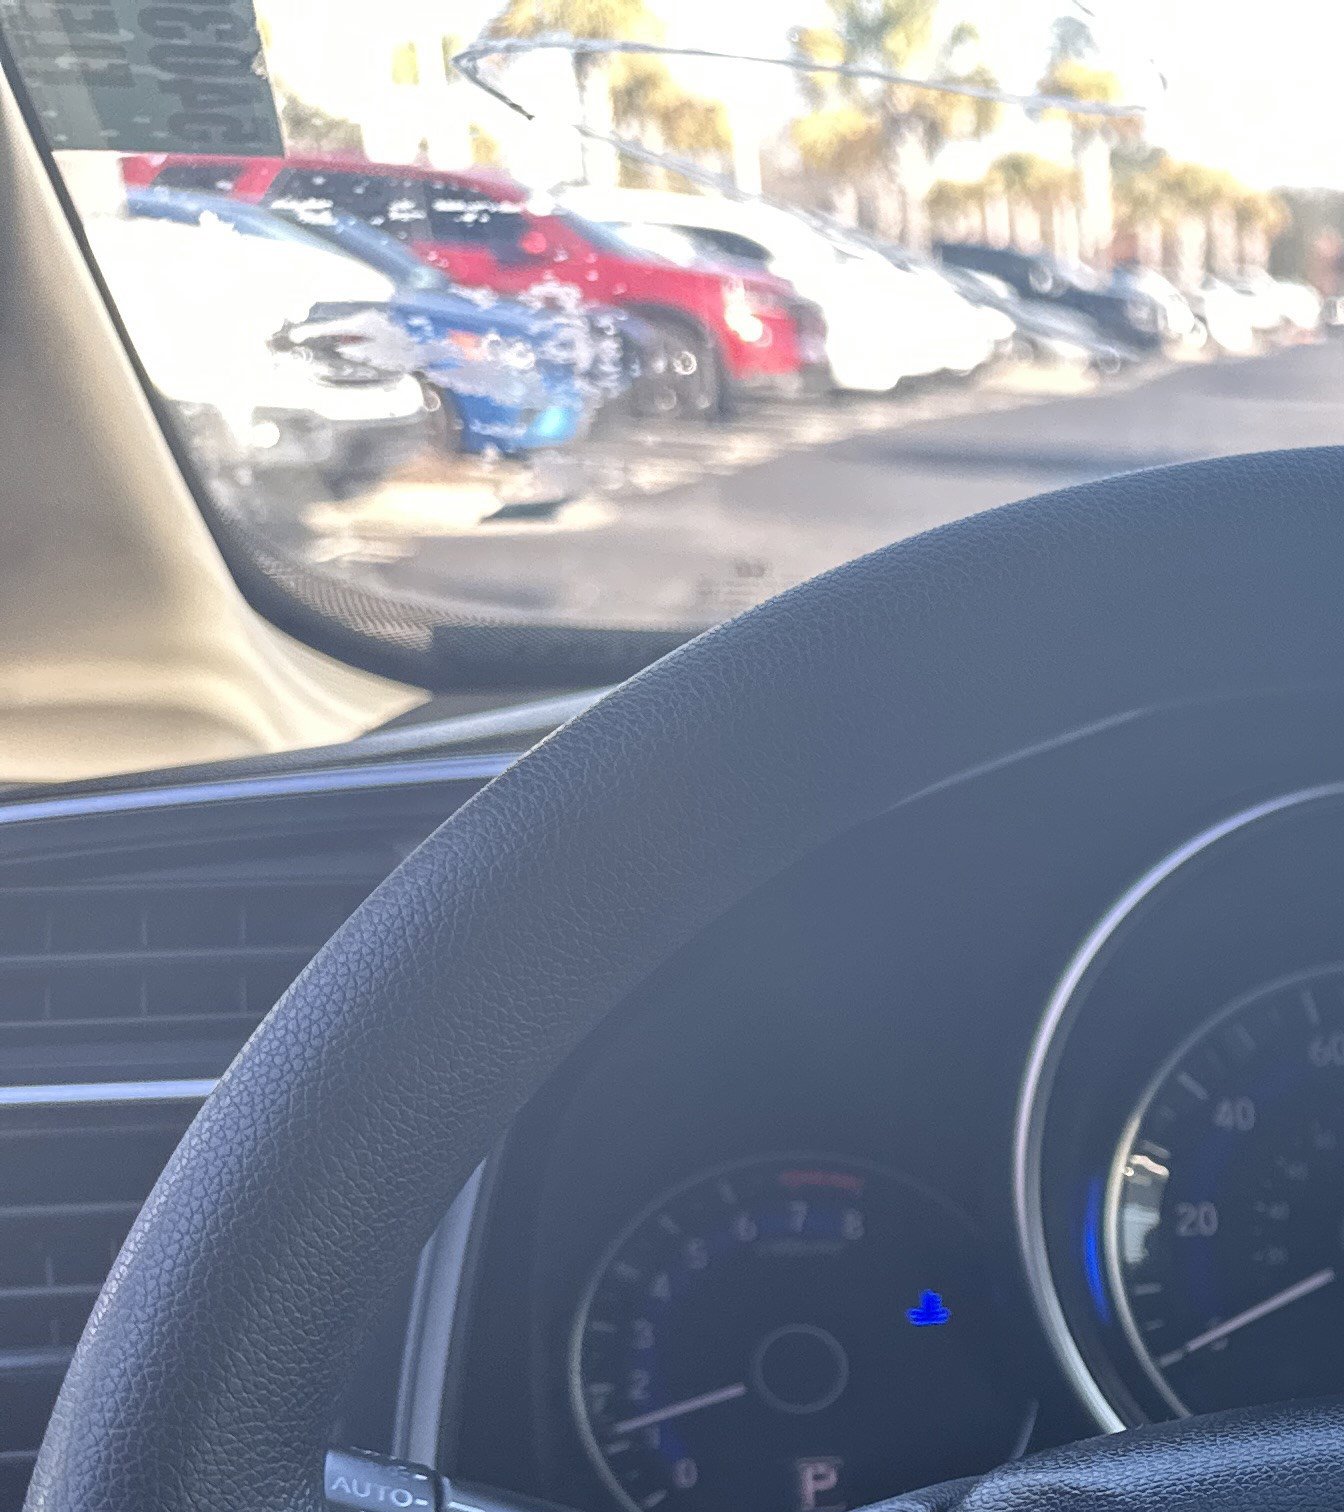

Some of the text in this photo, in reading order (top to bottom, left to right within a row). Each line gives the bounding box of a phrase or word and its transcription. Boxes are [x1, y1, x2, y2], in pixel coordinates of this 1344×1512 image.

[1214, 1097, 1256, 1131] 40
[1176, 1202, 1218, 1236] 20
[331, 1476, 413, 1507] AUTO
[801, 1462, 839, 1508] P
